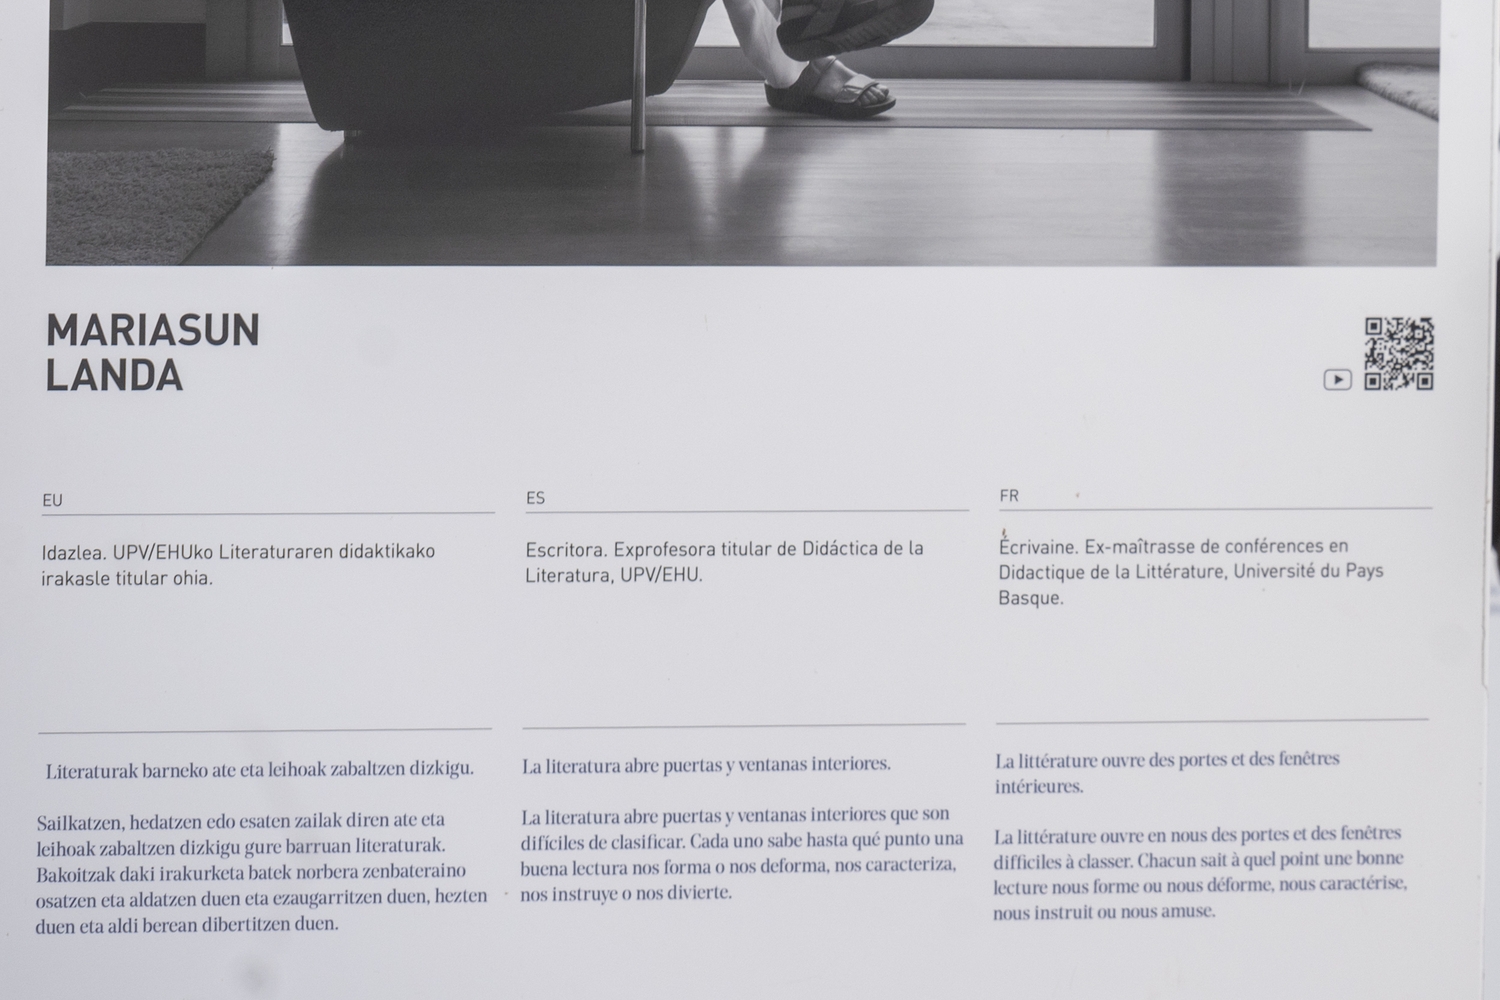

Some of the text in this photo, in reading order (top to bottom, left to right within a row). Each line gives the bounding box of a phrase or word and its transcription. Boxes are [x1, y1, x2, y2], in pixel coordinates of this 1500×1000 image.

[47, 312, 259, 347] MARIASUN
[46, 357, 184, 392] LANDA
[42, 493, 63, 508] EU
[526, 490, 546, 505] ES
[1000, 488, 1020, 503] FR
[42, 542, 436, 562] Idazlea. UPV/EHUko Literaturaren didaktikako
[526, 539, 924, 562] Escritora. Exprofesora titular de Didáctica de la
[999, 534, 1349, 556] Écrivaine. Ex-maîtrasse de conférences en
[41, 569, 213, 587] irakasle titular ohia.
[525, 564, 703, 585] Literatura, UPV/EHU.
[999, 561, 1385, 584] Didactique de la Littérature, Université du Pays
[998, 589, 1064, 610] Basque.
[45, 759, 474, 780] Literaturak barneko ate eta leihoak zabaltzen dizkigu.
[522, 755, 891, 778] La literatura abre puertas y ventanas interiores.
[995, 750, 1341, 772] La littérature ouvre des portes et des fenêtres
[995, 778, 1084, 795] intérieures.
[36, 811, 445, 833] Sailkatzen, hedatzen edo esaten zailak diren ate eta
[521, 806, 950, 829] La literatura abre puertas y ventanas interiores que son
[520, 830, 964, 852] difíciles de clasificar. Cada uno sabe hasta qué punto una
[994, 824, 1402, 847] La littérature ouvre en nous des portes et des fenêtres
[36, 836, 446, 860] leihoak zabaltzen dizkigu gure barruan literaturak.
[993, 849, 1405, 872] difficiles à classer. Chacun sait à quel point une bonne
[36, 862, 467, 884] Bakoitzak daki irakurketa batek norbera zenbateraino
[520, 883, 733, 906] nos instruye o nos divierte.
[993, 904, 1216, 922] nous instruit ou nous amuse.
[35, 914, 339, 935] duen eta aldi berean dibertitzen duen.
